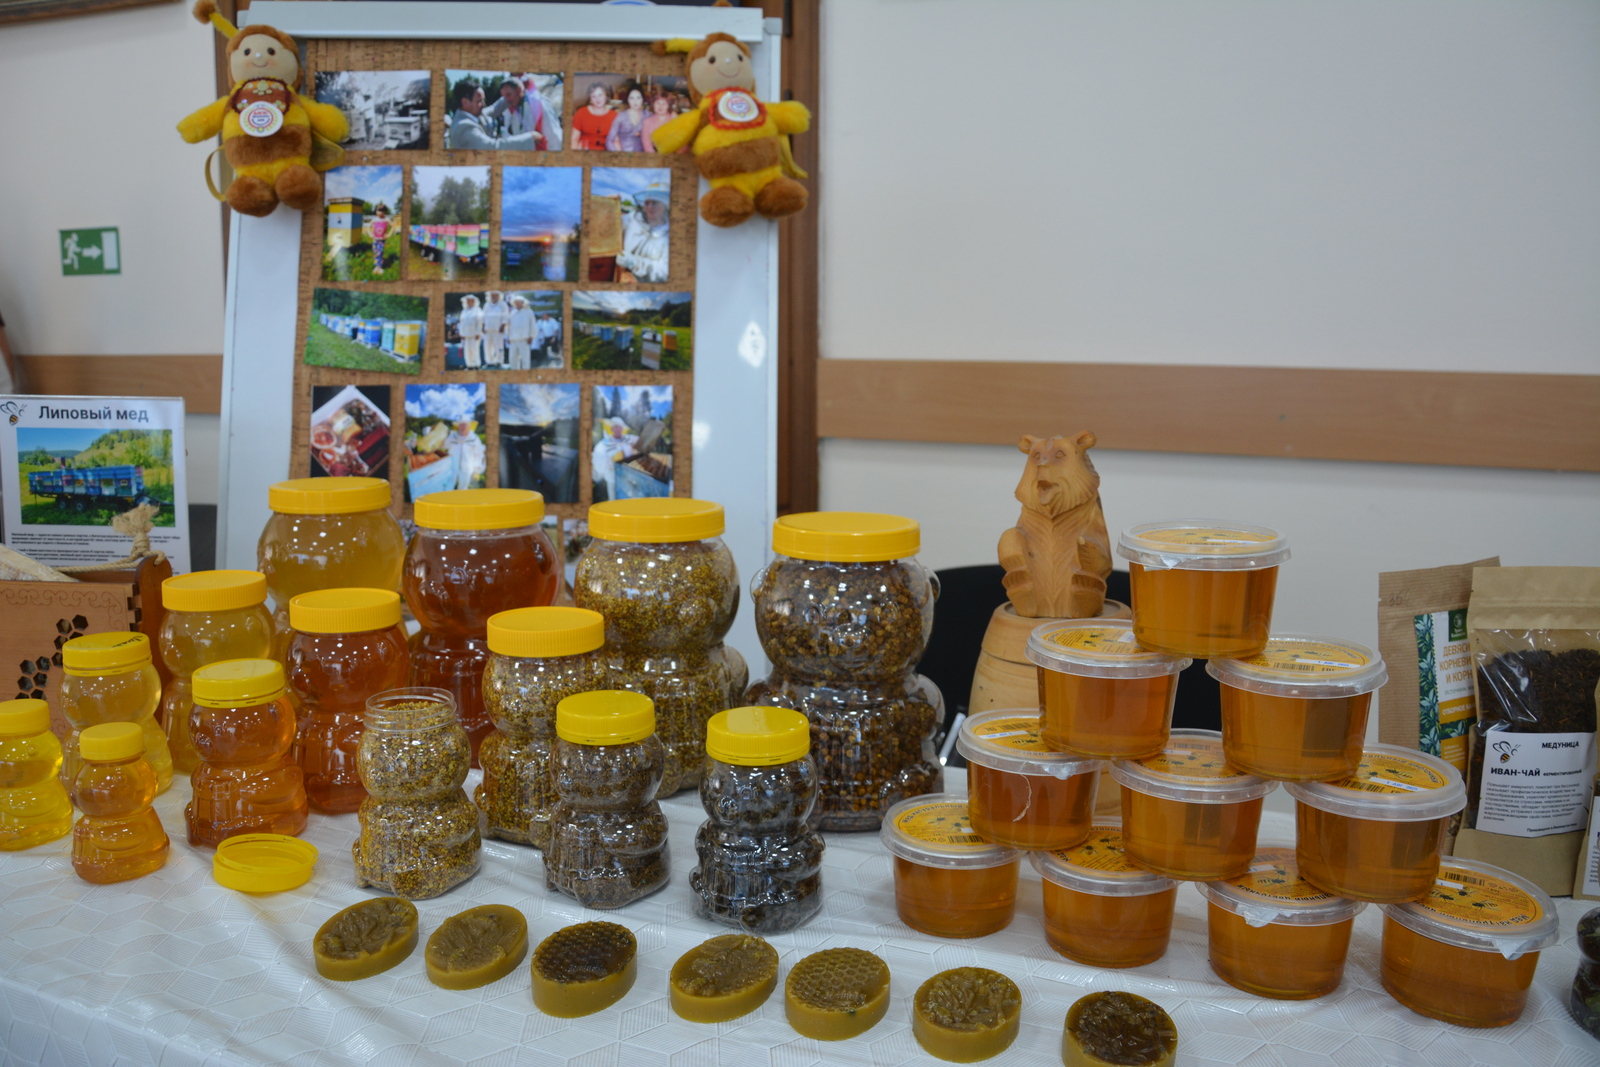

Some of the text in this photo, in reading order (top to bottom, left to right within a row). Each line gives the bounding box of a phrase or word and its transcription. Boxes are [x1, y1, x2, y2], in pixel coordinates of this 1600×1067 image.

[39, 405, 149, 422] Липовый мед
[1443, 642, 1471, 658] ДЕВЯСИ
[1439, 656, 1472, 671] КОРНЕВИ
[1452, 670, 1473, 683] КОРН
[1541, 741, 1580, 749] МЕДУНИЦА
[1490, 767, 1541, 777] ИВАН-ЧАЙ
